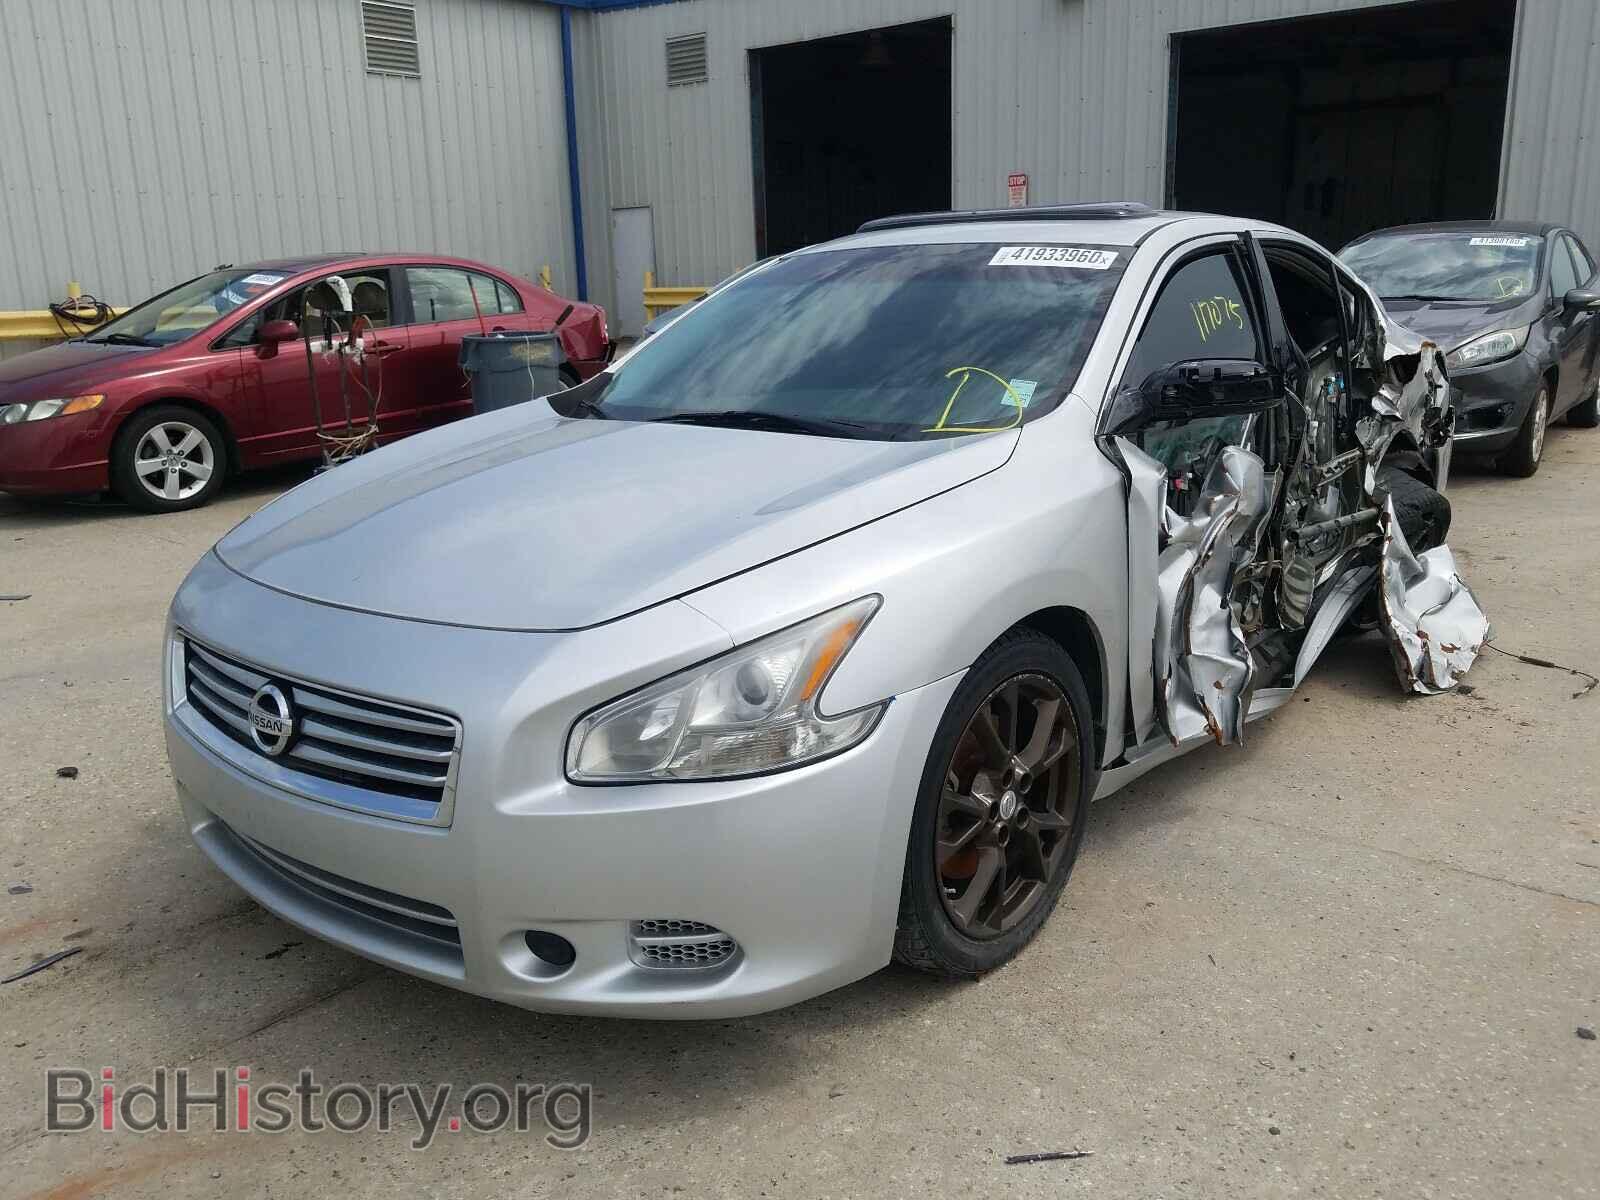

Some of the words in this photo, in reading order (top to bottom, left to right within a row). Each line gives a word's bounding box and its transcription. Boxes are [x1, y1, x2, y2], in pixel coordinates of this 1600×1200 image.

[1008, 176, 1026, 185] STOP
[1011, 247, 1102, 263] 41933960
[919, 366, 1023, 433] D
[249, 711, 283, 732] NISSAN
